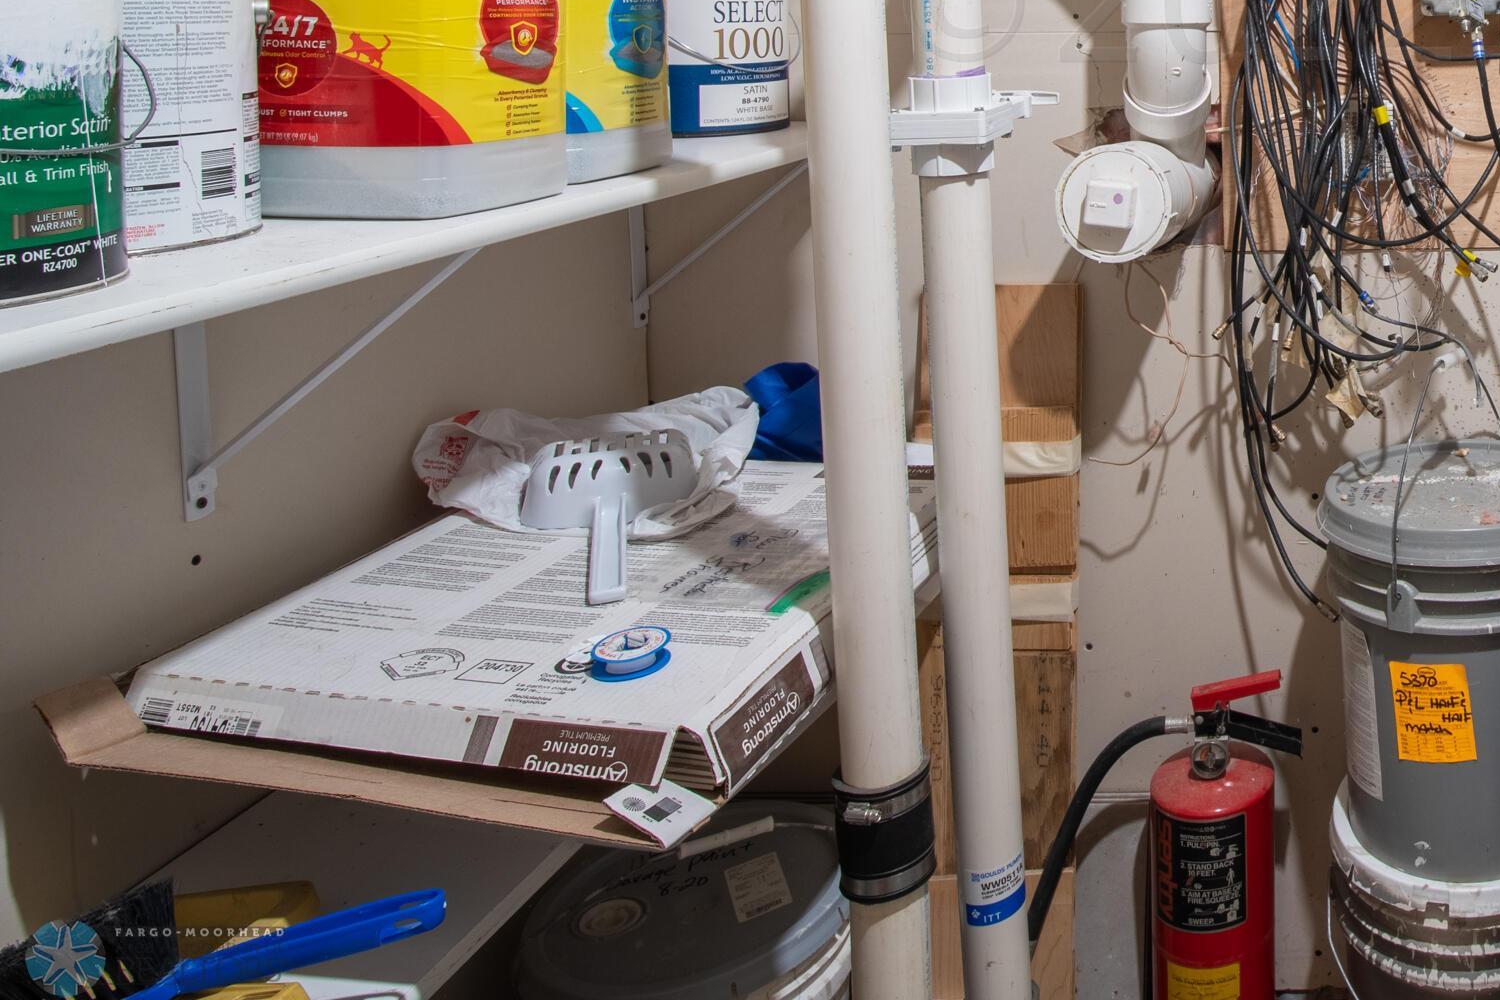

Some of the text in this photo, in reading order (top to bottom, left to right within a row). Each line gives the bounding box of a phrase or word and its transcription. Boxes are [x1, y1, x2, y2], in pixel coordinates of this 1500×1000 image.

[713, 0, 783, 23] SELECT
[713, 27, 783, 59] 1000
[743, 85, 768, 94] SATIN
[742, 96, 769, 104] 88-4790
[70, 116, 109, 136] Satin
[25, 169, 38, 183] &
[43, 167, 76, 181] Trim
[79, 160, 109, 177] Finish
[37, 209, 78, 223] LIFETIME
[31, 217, 83, 233] WARRANTY
[93, 233, 118, 249] WHITE
[43, 257, 78, 273] RZ4700
[477, 662, 523, 673] 204730
[744, 688, 786, 733] FLOORING
[740, 691, 800, 757] Armstrong
[560, 729, 611, 742] PREMIUM TILE
[542, 739, 616, 758] FLOORING
[524, 755, 627, 783] Armstrong
[1213, 859, 1234, 868] BACK
[980, 866, 1005, 879] GOULDS
[658, 876, 708, 896] 8-20
[1212, 888, 1232, 896] BASE
[983, 912, 1001, 923] ITT
